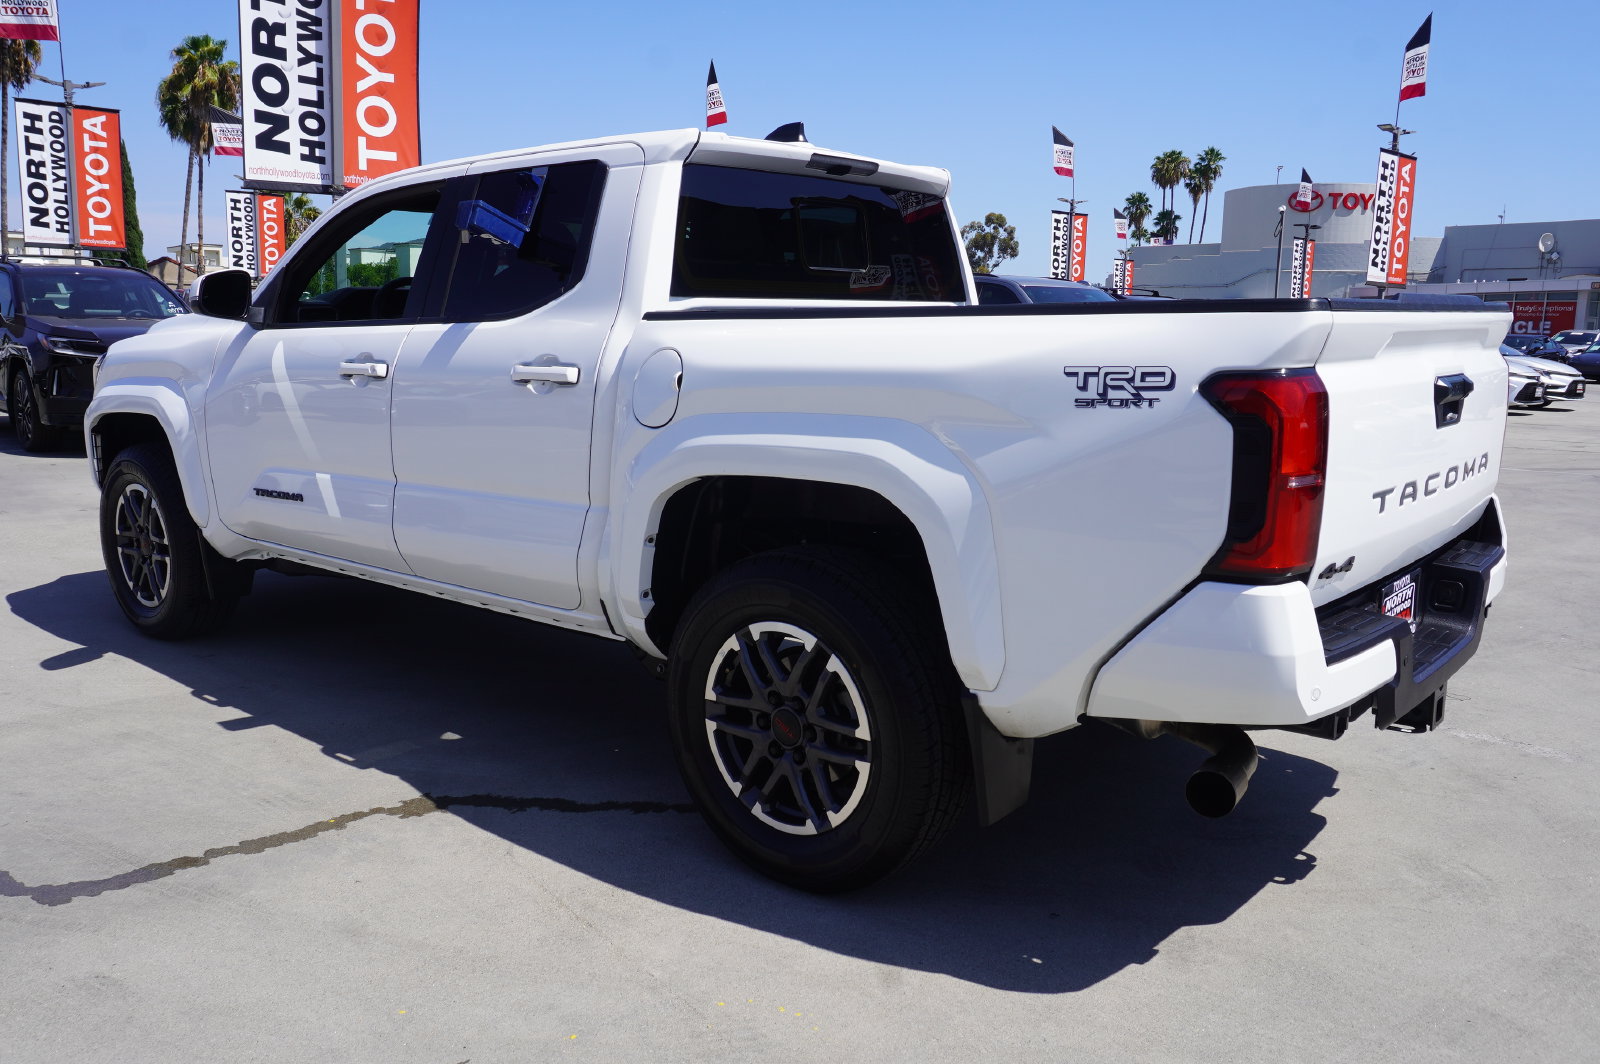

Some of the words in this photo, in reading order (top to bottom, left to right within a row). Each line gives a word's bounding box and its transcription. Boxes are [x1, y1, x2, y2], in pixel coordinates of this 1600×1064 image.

[1, 6, 49, 15] TOYOTA
[23, 111, 50, 229] NORTH
[49, 110, 70, 234] HOLLYWOOD
[82, 114, 112, 236] TOYOTA
[248, 166, 330, 181] northhollywoodtoyota.com
[1328, 192, 1376, 210] TOY
[230, 197, 244, 267] NORTH
[244, 197, 255, 270] HOLLYWOOD
[263, 198, 279, 272] TOYOTA
[1371, 160, 1389, 268] NORTH
[1380, 159, 1395, 273] HOLLYWOOD
[1392, 163, 1412, 275] TOYOTA
[1060, 216, 1069, 279] OLLYWOOD
[1291, 242, 1300, 297] NORTH
[1064, 366, 1176, 399] TRD
[1074, 398, 1161, 409] SPORT
[253, 488, 304, 502] TACOMA
[1372, 452, 1489, 514] TACOMA
[1385, 586, 1413, 612] NORTH
[1393, 574, 1411, 592] TOYOTA
